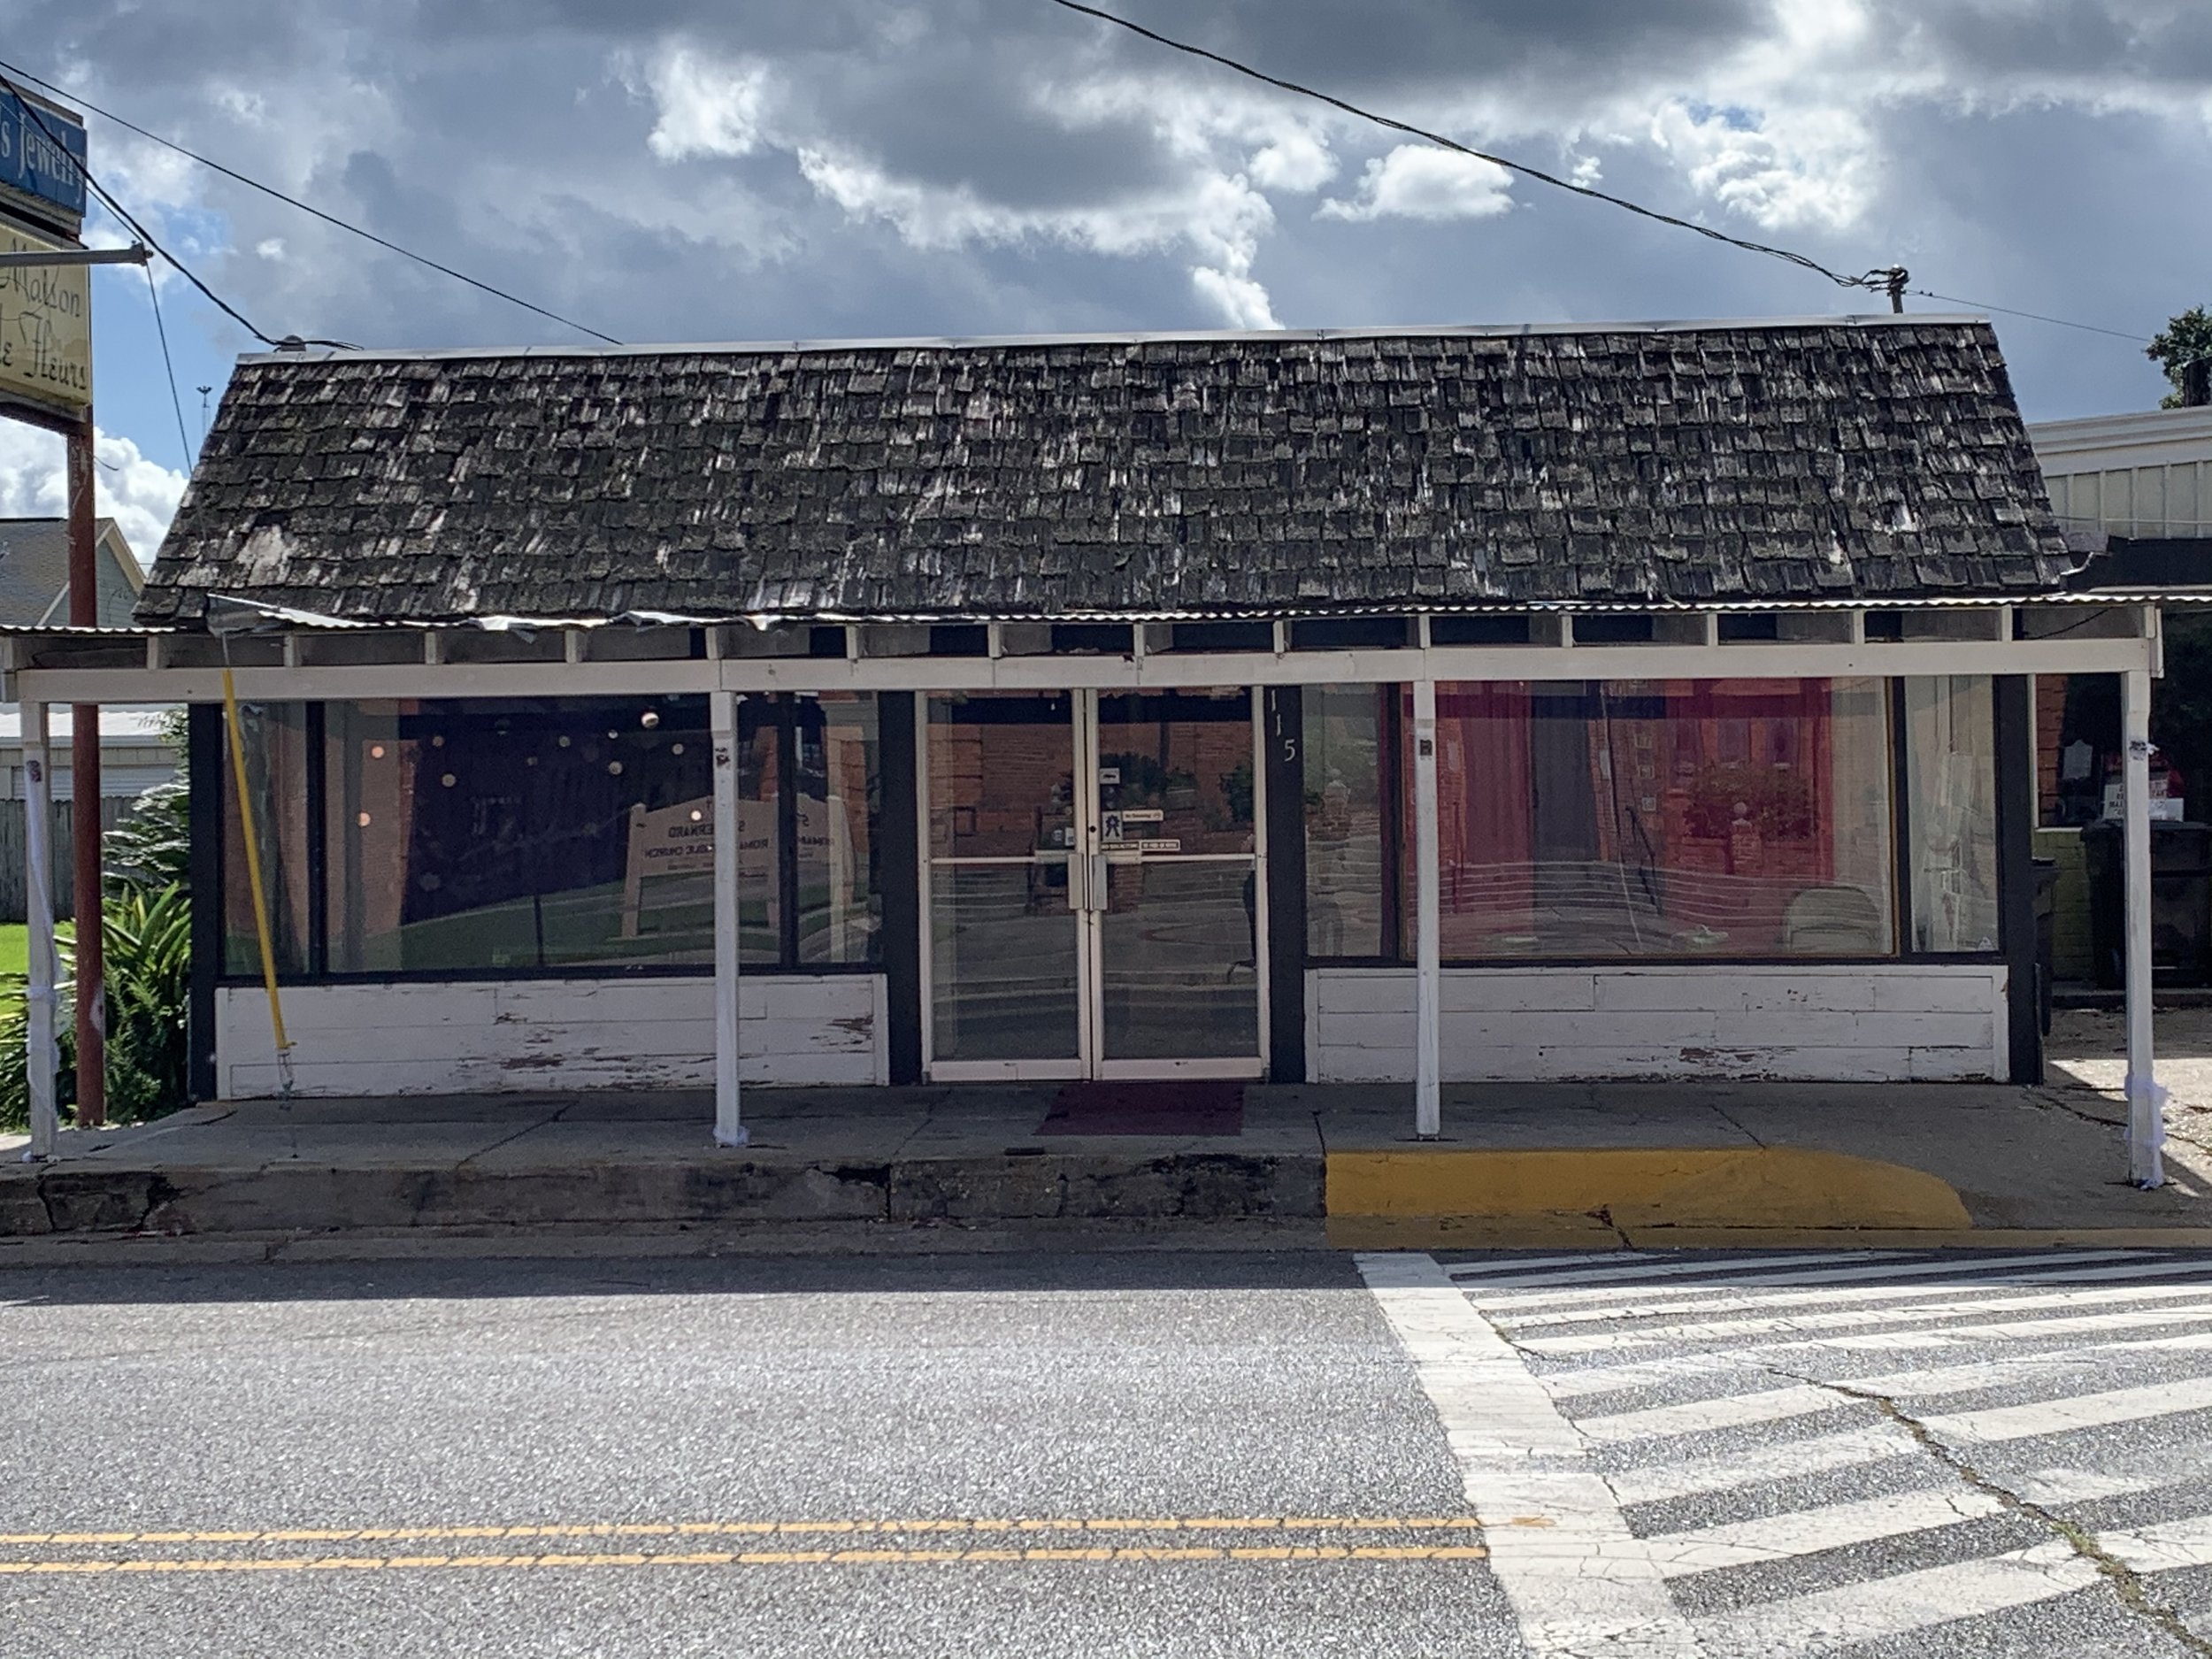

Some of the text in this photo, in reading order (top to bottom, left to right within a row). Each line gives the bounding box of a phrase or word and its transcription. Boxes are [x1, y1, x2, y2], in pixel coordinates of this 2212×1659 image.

[18, 111, 86, 204] Jewelry
[9, 237, 81, 318] Maison
[19, 311, 87, 390] Fleurs
